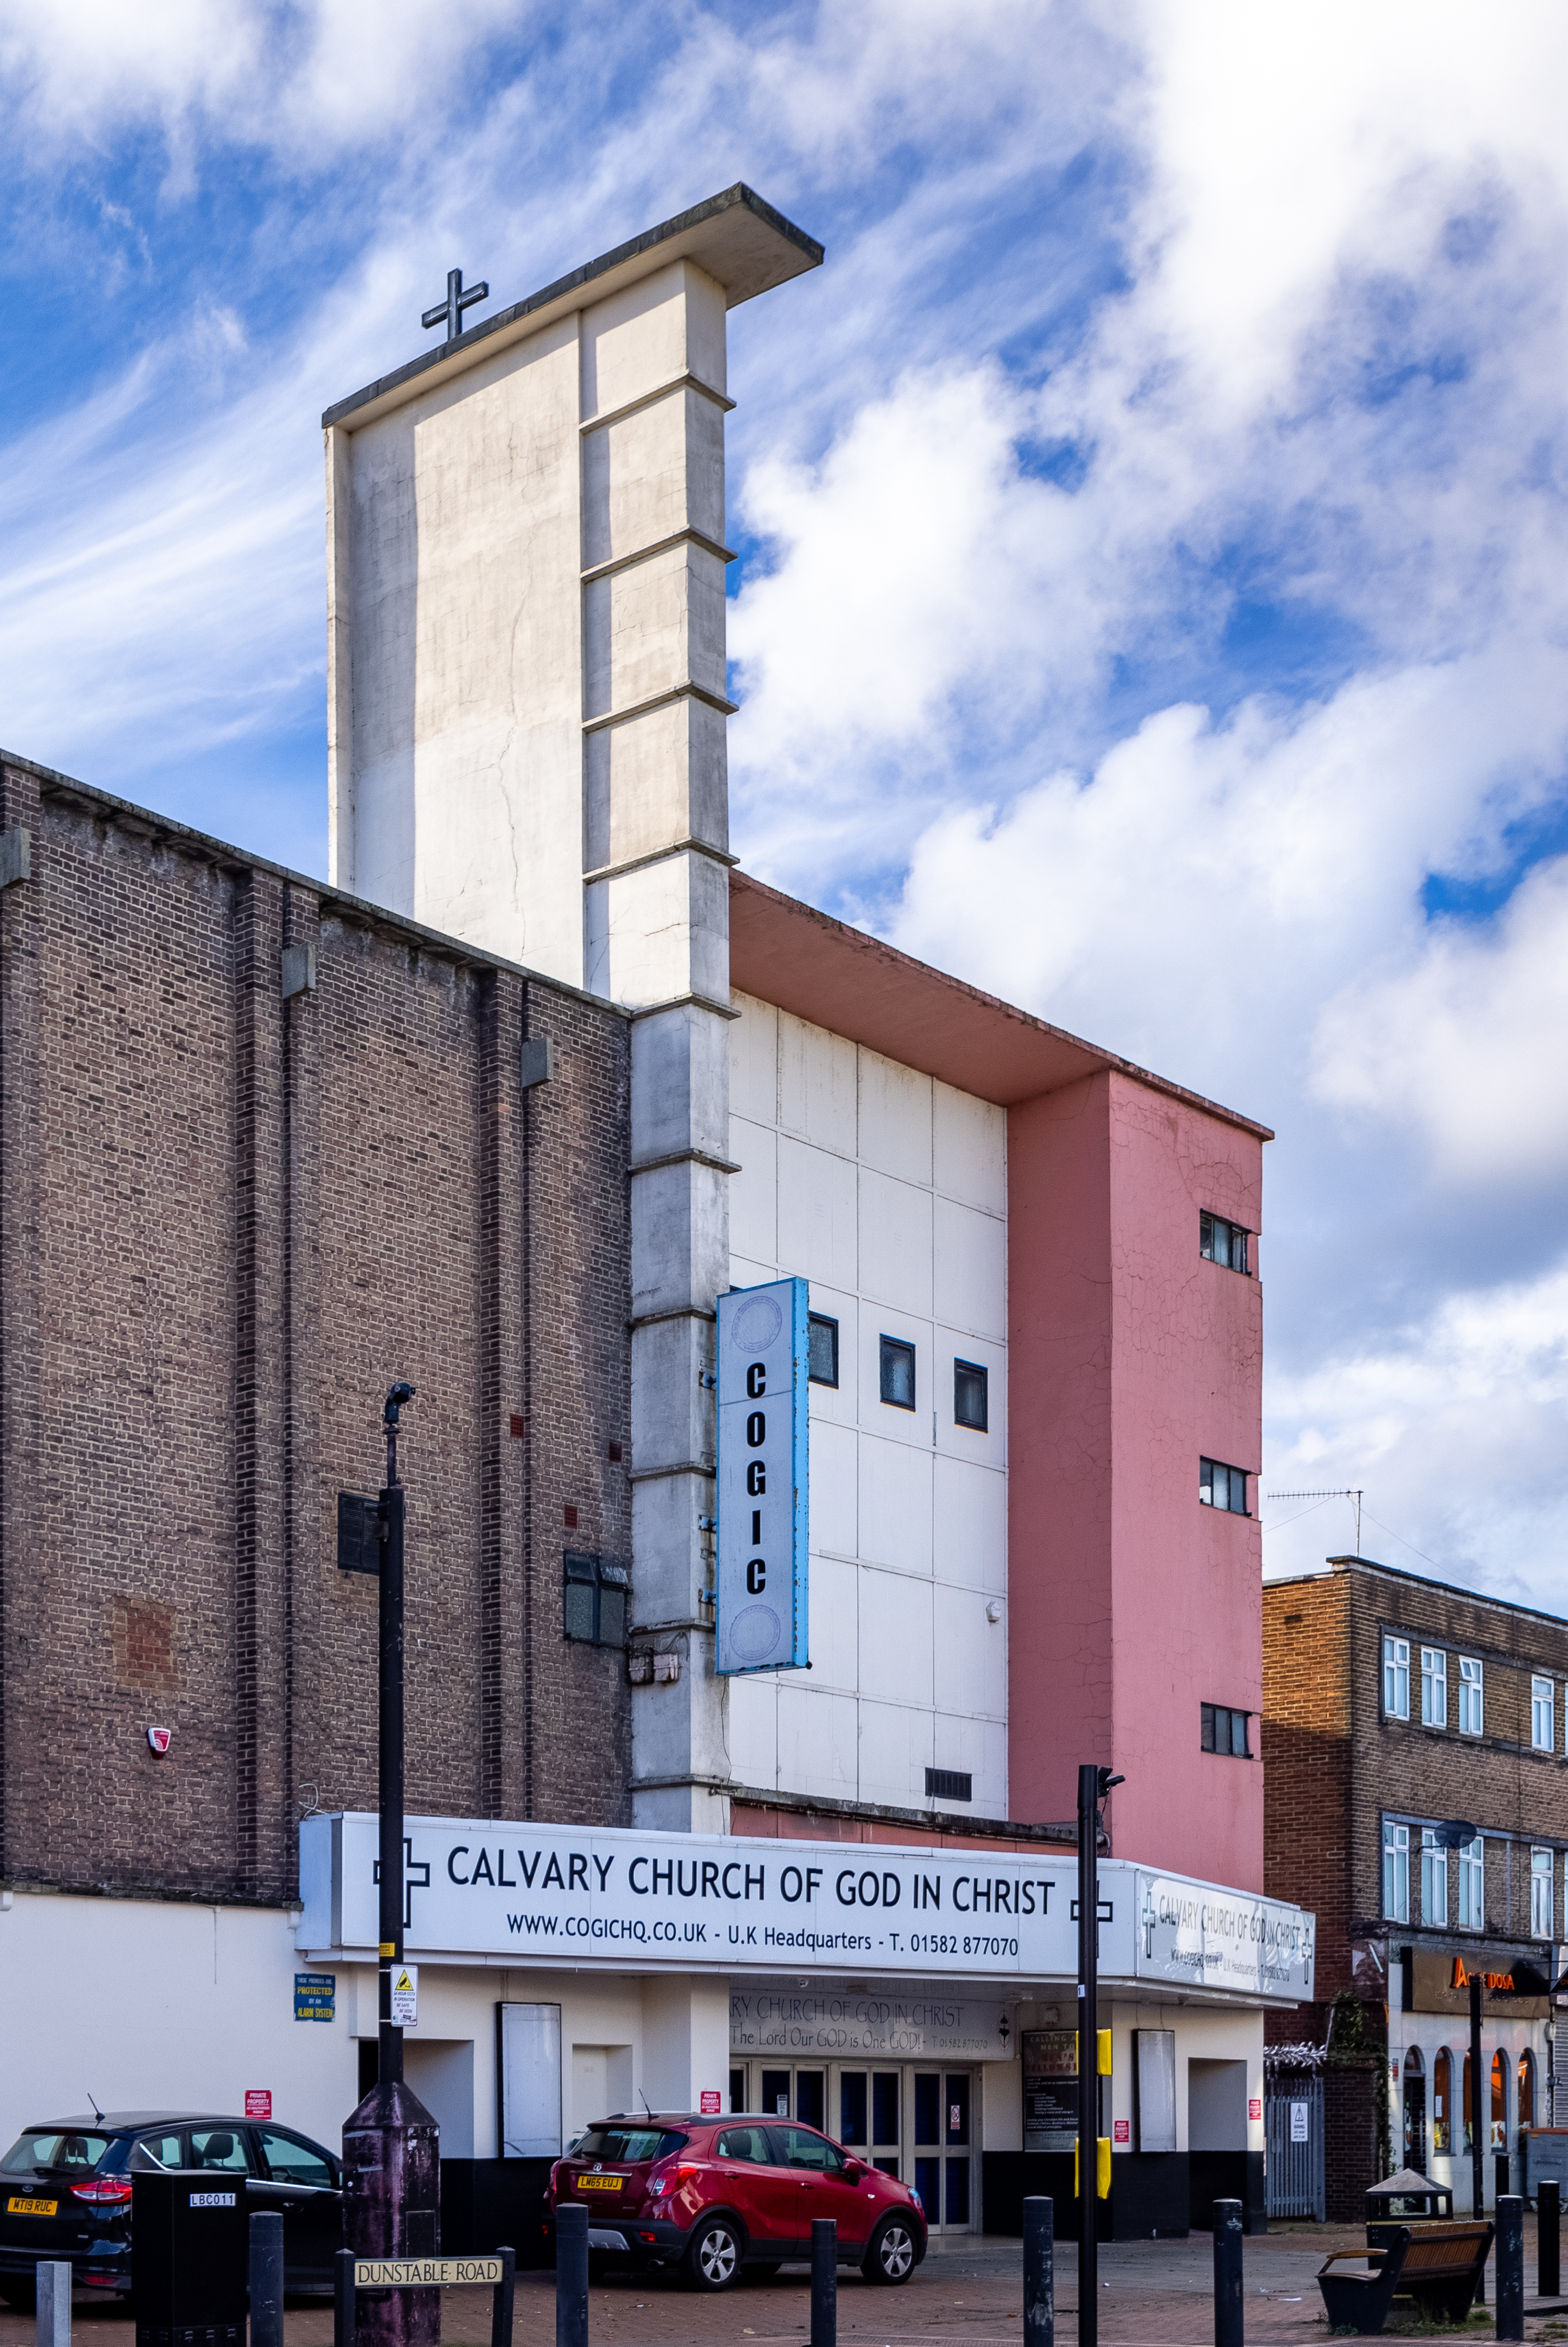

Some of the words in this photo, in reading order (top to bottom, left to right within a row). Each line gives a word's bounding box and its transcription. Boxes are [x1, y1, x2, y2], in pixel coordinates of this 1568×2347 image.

[746, 1362, 766, 1595] COGIC
[447, 1846, 615, 1892] CALVARY
[628, 1856, 765, 1900] CHURCH
[780, 1865, 823, 1903] OF
[835, 1870, 901, 1907] GOD
[913, 1874, 941, 1910] IN
[952, 1876, 1056, 1915] CHRIST
[1159, 1895, 1198, 1929] CALVARY
[1201, 1904, 1235, 1937] CHURCH
[1237, 1913, 1248, 1940] OF
[1250, 1915, 1265, 1943] GOD
[1267, 1920, 1275, 1946] IN
[1275, 1921, 1300, 1950] CHRIST
[506, 1914, 707, 1943] WWW.COGICHQ.CO.UK
[728, 1924, 757, 1944] U.K
[765, 1926, 871, 1952] Headquarters
[889, 1933, 904, 1952] T.
[911, 1934, 958, 1954] 01582
[963, 1936, 1018, 1956] 877070
[297, 1987, 333, 1995] PROTECTED
[298, 2008, 314, 2017] ALARM
[315, 2008, 333, 2018] SYSTEM
[729, 1996, 752, 2018] RY
[757, 1996, 825, 2021] CHURCH
[830, 2000, 851, 2021] OF
[855, 2001, 890, 2023] GOD
[894, 2003, 907, 2024] IN
[912, 2003, 964, 2027] CHRIST
[730, 2022, 754, 2044] The
[759, 2024, 786, 2045] Lord
[790, 2027, 814, 2046] Our
[817, 2028, 847, 2047] GOD
[850, 2030, 859, 2047] is
[862, 2030, 886, 2049] One
[890, 2030, 920, 2049] GOD!
[1030, 2035, 1066, 2043] CALLING
[602, 2178, 619, 2188] EUJ
[14, 2199, 33, 2211] MT19
[34, 2200, 52, 2212] RUC
[192, 2194, 233, 2205] LBC011
[358, 2263, 449, 2283] DUNSTABLE
[456, 2262, 498, 2280] ROAD
